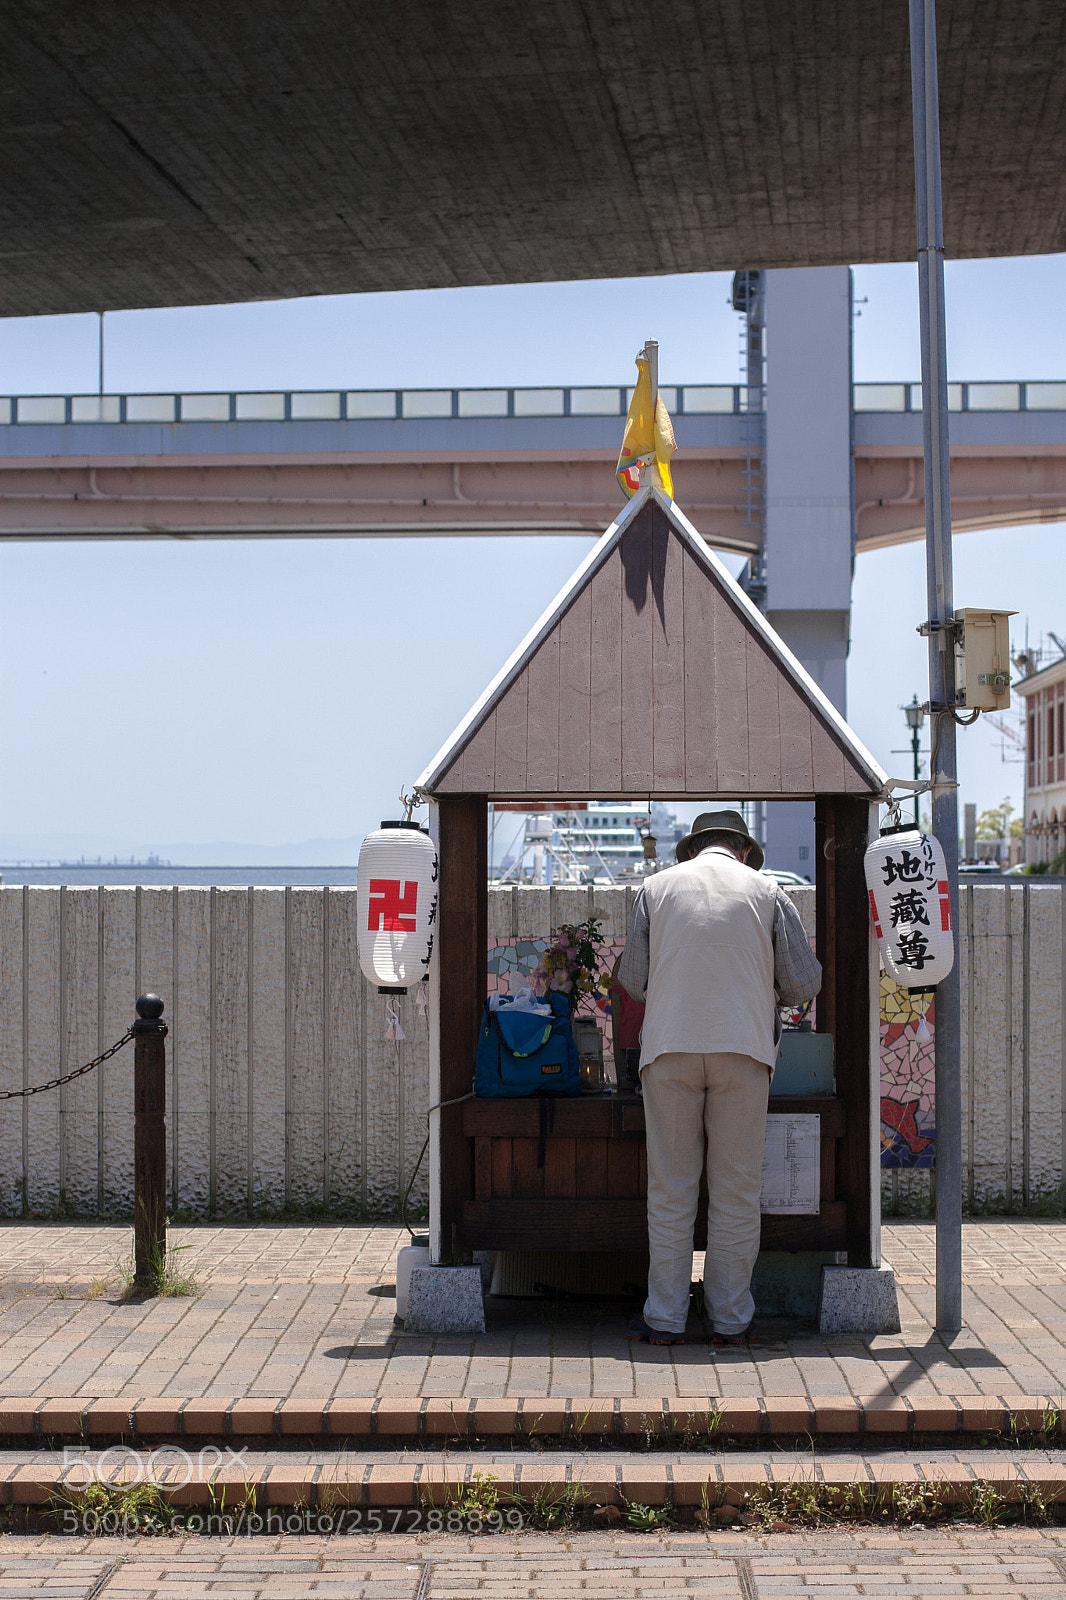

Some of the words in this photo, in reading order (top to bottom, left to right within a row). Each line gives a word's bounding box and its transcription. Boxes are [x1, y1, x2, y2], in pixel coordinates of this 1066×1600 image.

[920, 834, 938, 890] メリケン
[881, 850, 935, 970] 地蔵尊
